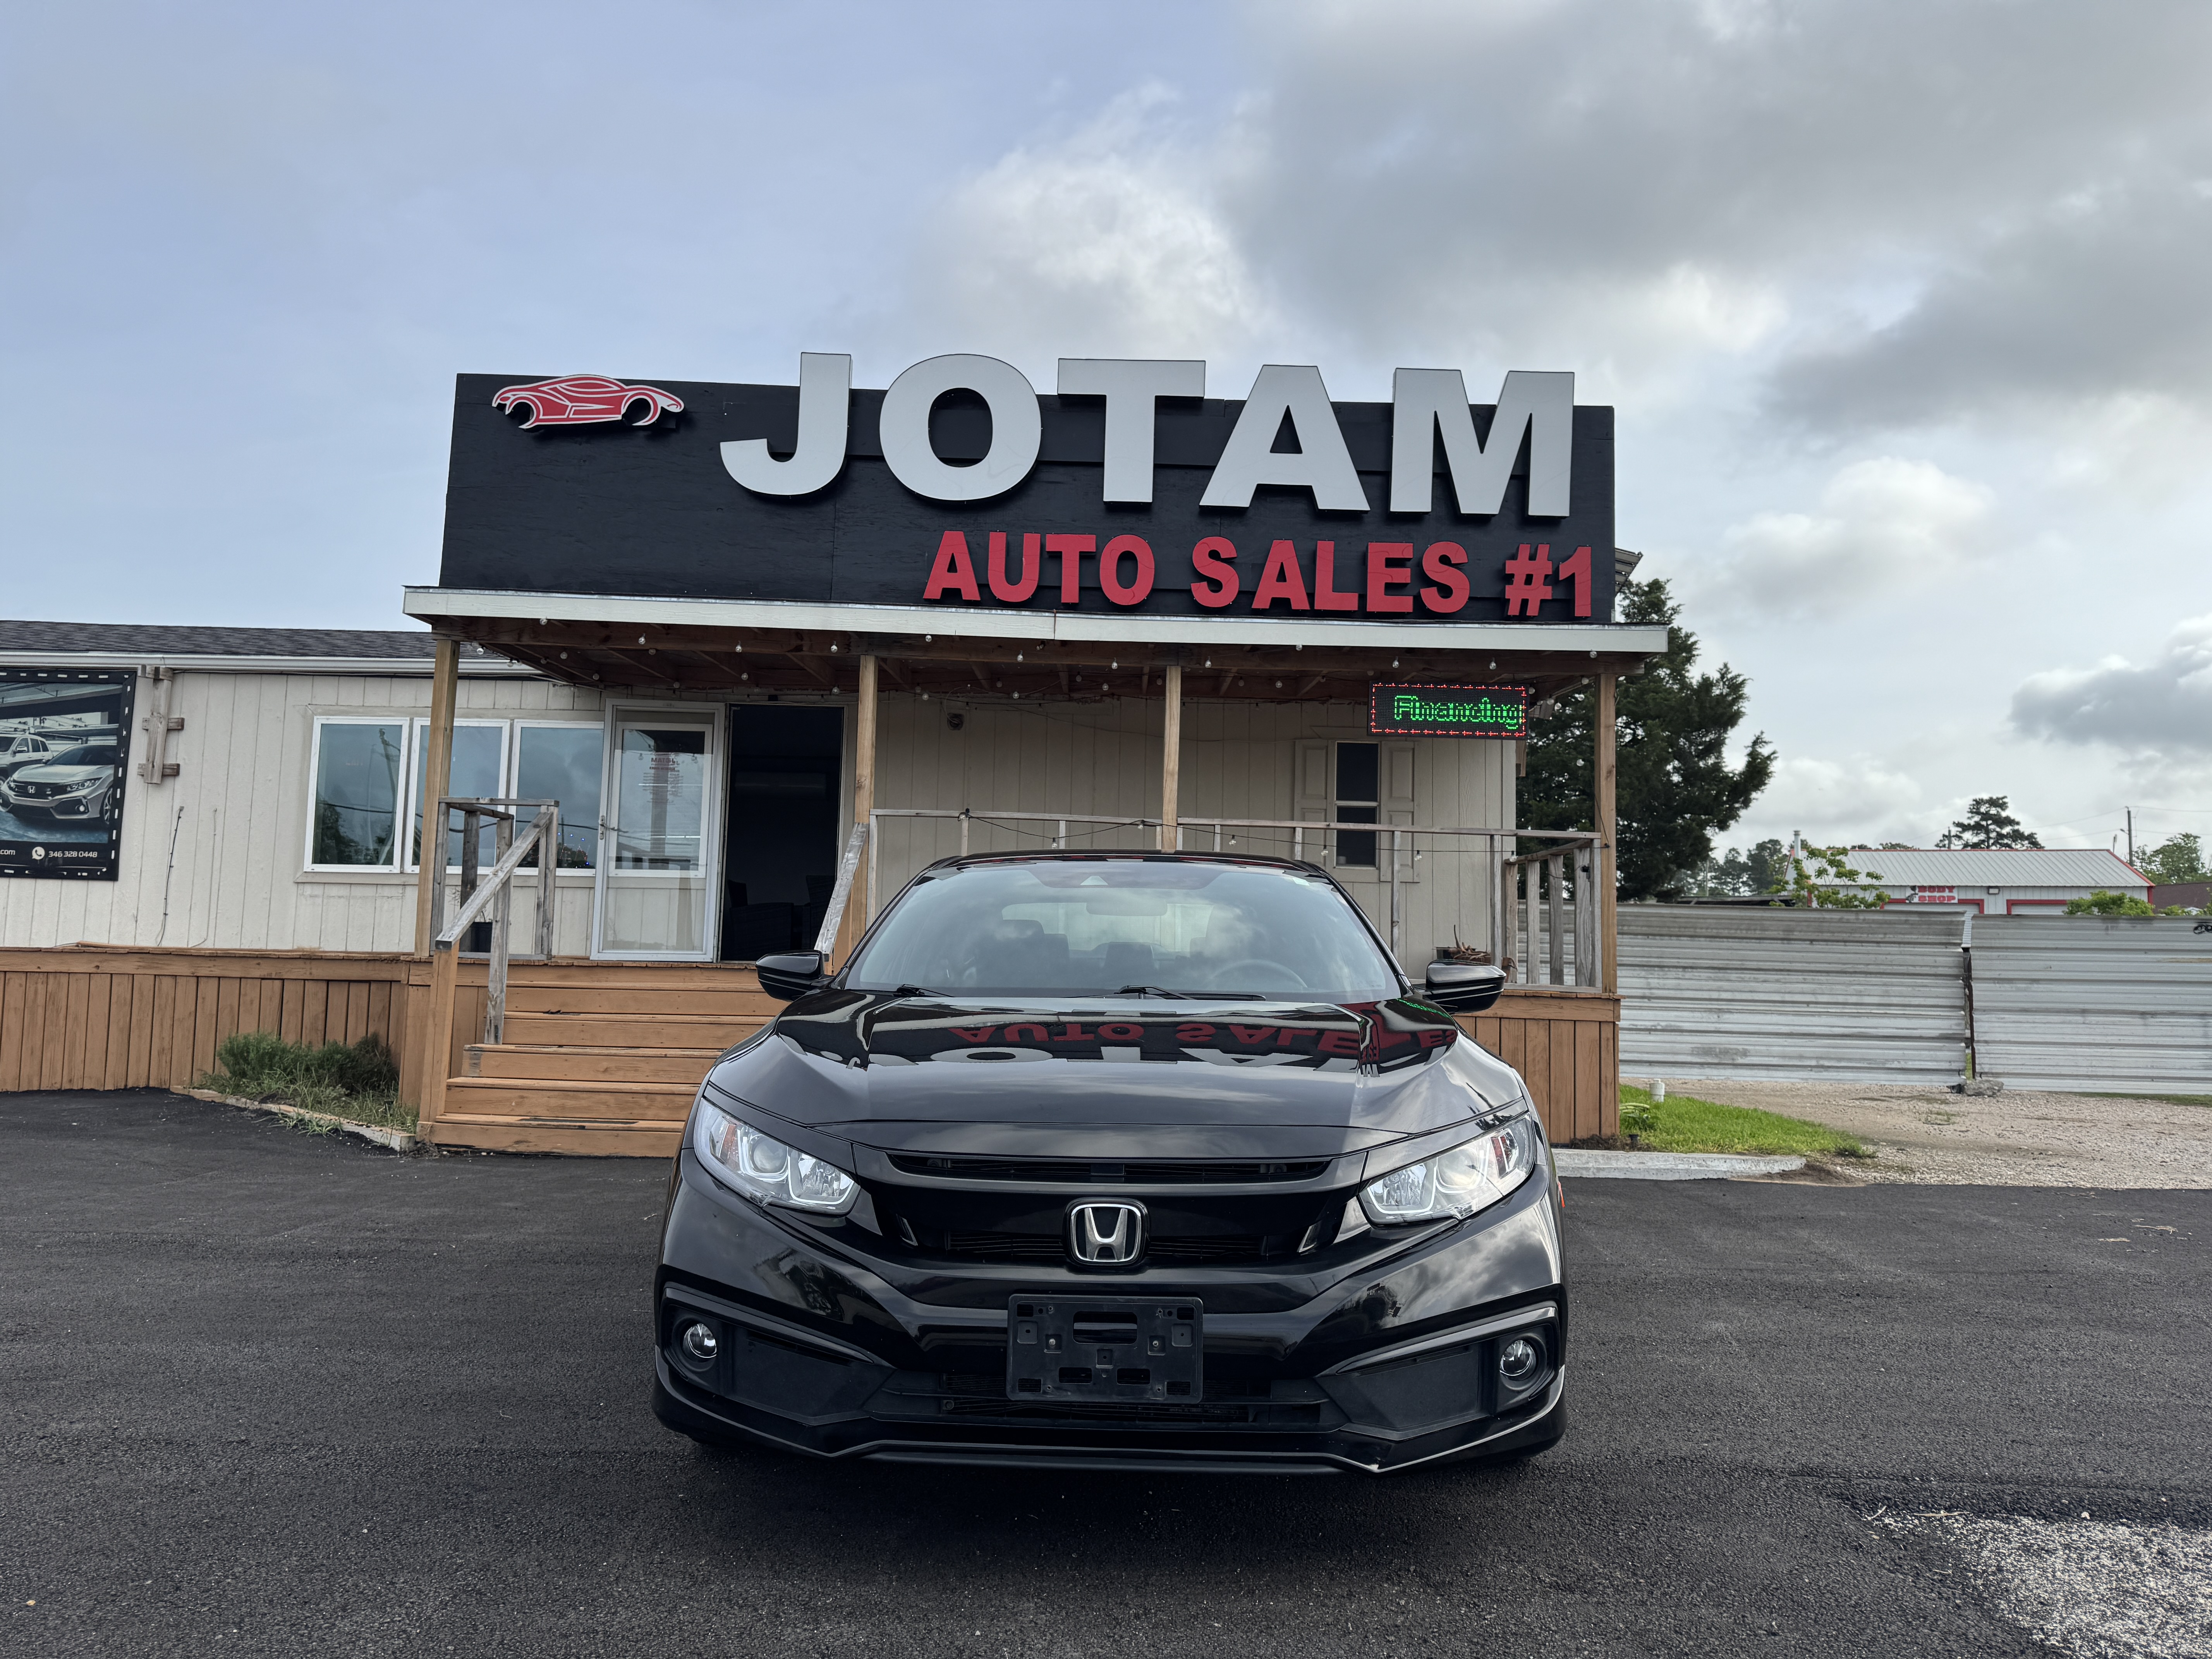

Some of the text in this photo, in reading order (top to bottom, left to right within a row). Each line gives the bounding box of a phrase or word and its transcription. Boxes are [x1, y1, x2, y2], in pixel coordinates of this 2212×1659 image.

[720, 352, 1575, 517] JOTAM
[923, 530, 1592, 617] AUTO SALES #1
[1394, 695, 1522, 730] Financing
